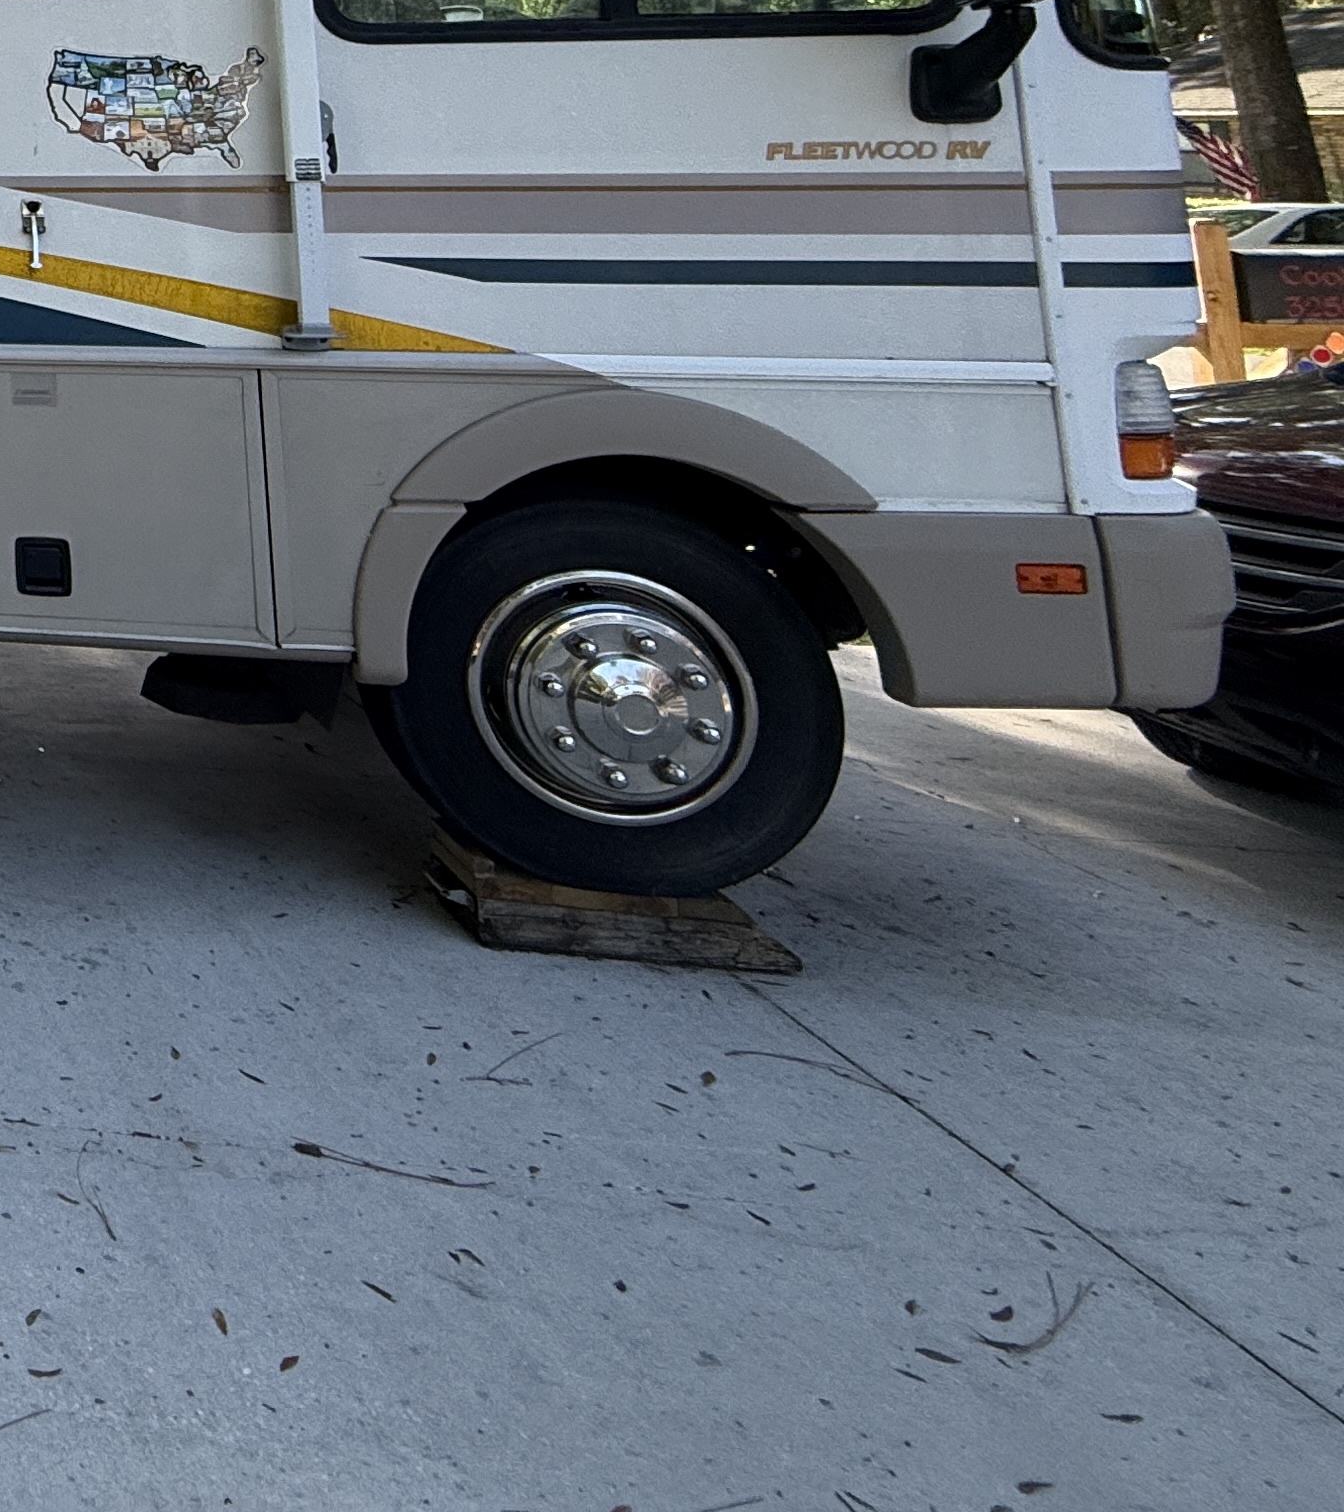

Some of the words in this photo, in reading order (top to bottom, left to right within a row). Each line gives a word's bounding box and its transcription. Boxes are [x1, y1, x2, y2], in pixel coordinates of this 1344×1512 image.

[765, 140, 938, 161] FLEETWOOD
[946, 140, 992, 160] RV
[1279, 264, 1344, 286] Coo
[1284, 295, 1344, 318] 325
